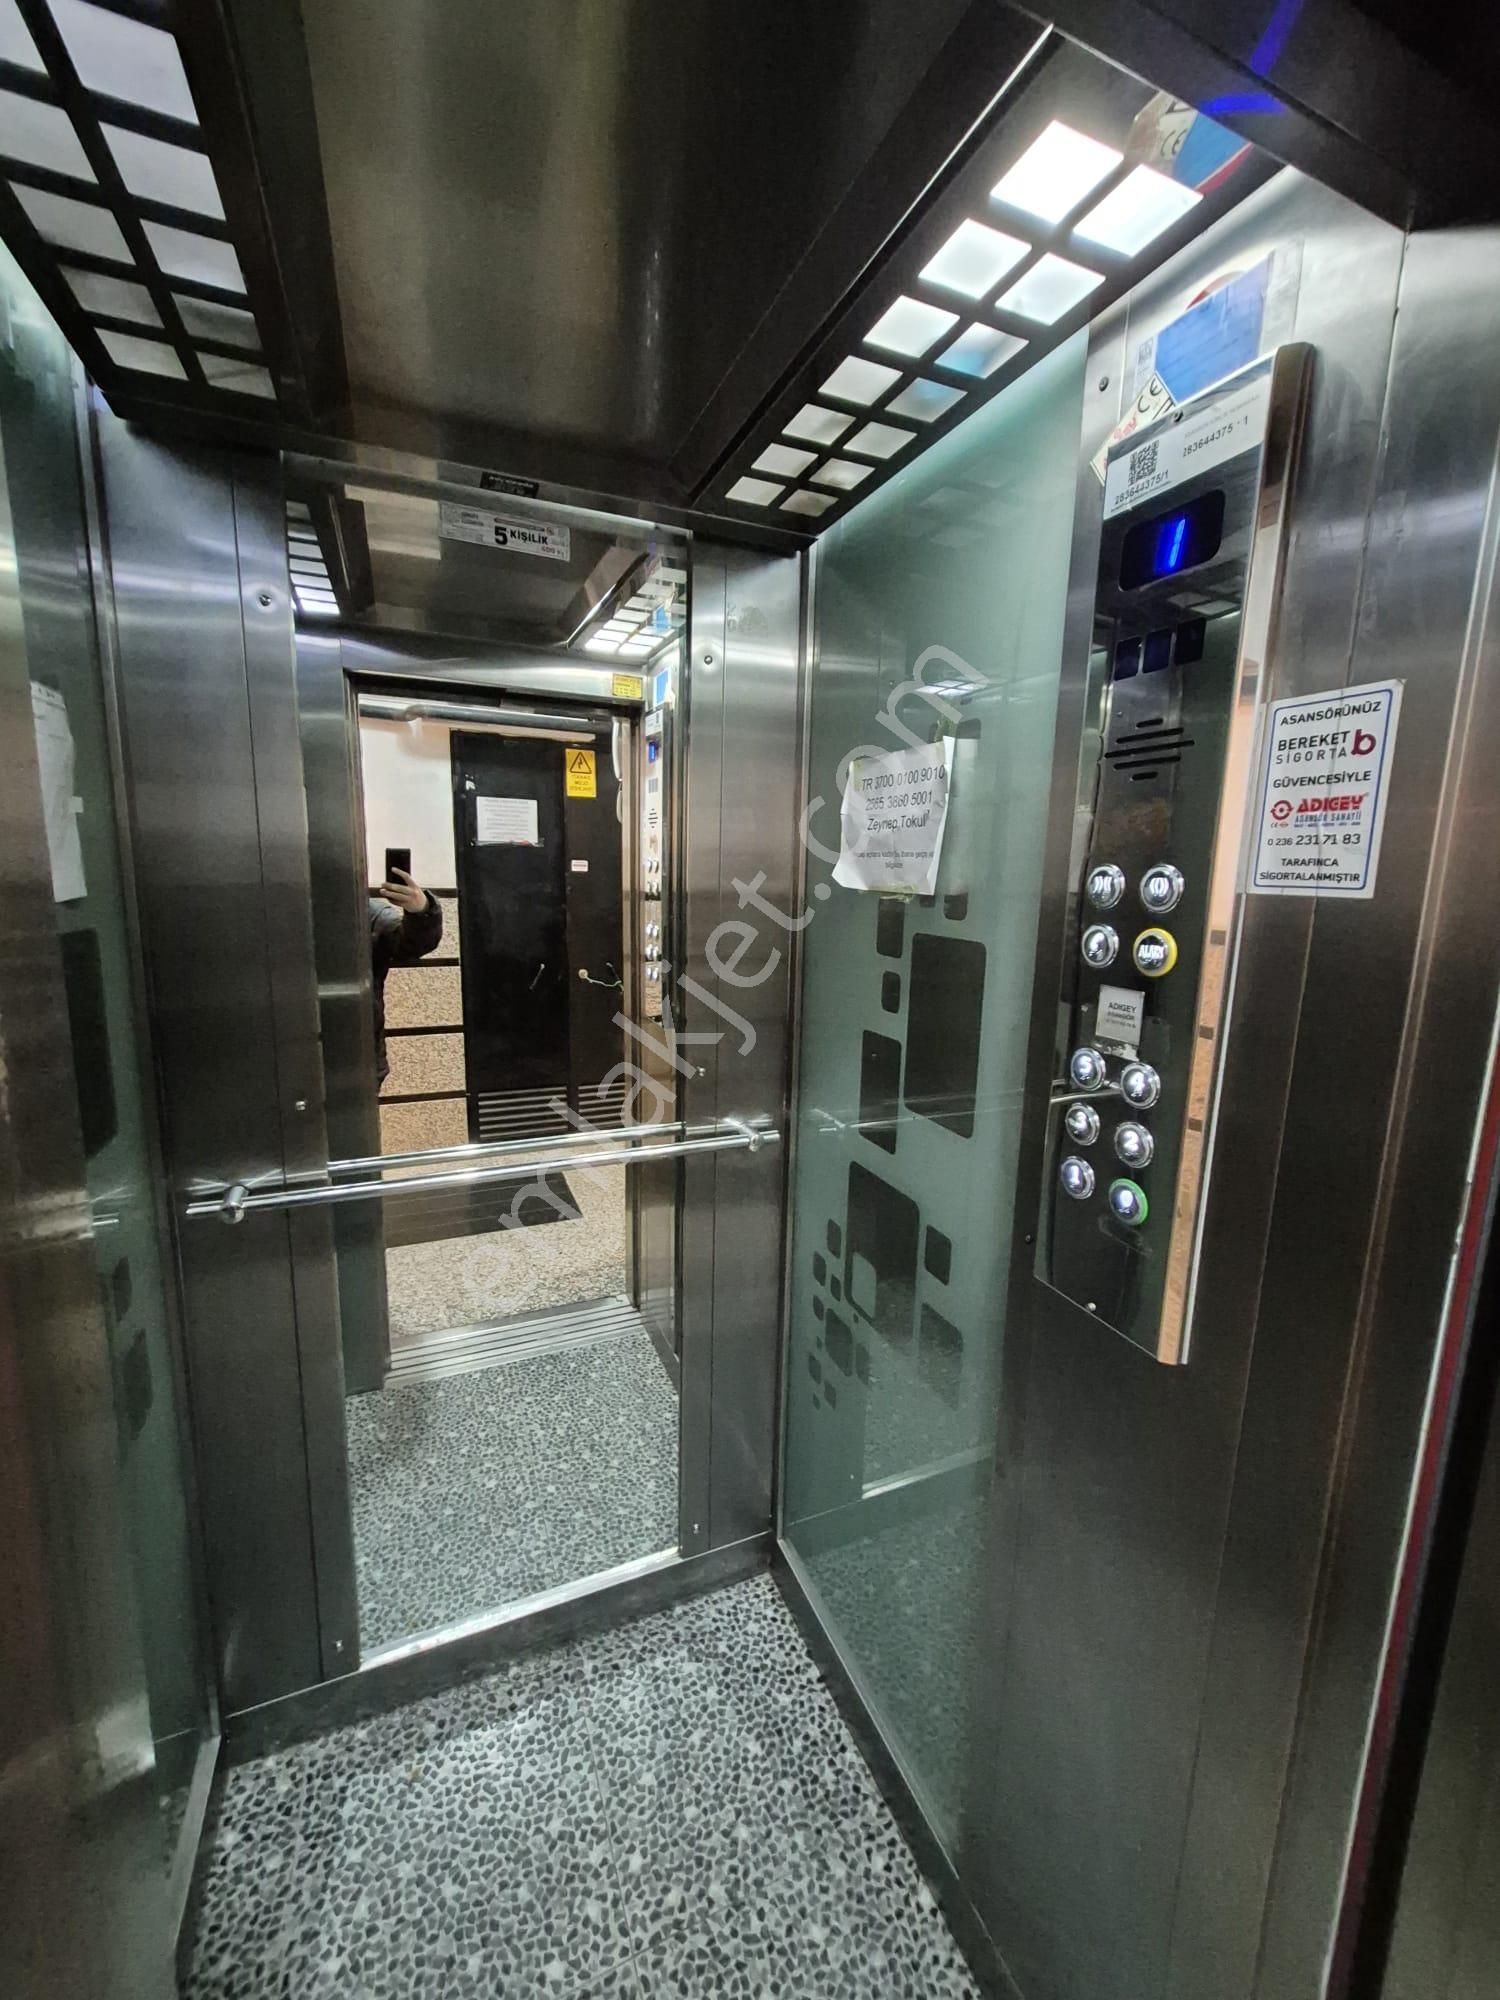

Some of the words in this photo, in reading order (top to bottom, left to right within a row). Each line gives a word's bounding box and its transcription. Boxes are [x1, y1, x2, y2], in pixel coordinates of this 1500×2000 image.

[494, 526, 508, 545] 5
[510, 528, 549, 545] KİŞİLİK
[1169, 518, 1186, 568] 1
[1280, 701, 1382, 726] ASANSÖRÜNÜZ
[1278, 731, 1350, 752] BEREKET
[1350, 729, 1377, 756] b
[1276, 747, 1347, 764] SİGORTA
[862, 778, 872, 791] TR
[875, 774, 894, 790] 3700
[897, 769, 919, 786] 0100
[921, 765, 945, 782] 9010
[1273, 770, 1371, 789] GÜVENCESİYLE
[910, 790, 932, 806] 5001
[867, 817, 898, 832] Zeynep
[1268, 838, 1273, 846] 0
[1275, 838, 1293, 846] 236
[1296, 834, 1320, 846] 231
[1323, 834, 1337, 845] 71
[1343, 833, 1361, 845] 83
[1281, 857, 1339, 867] TARAFINCA
[1259, 870, 1360, 884] SİGORTALANMIŞTIR
